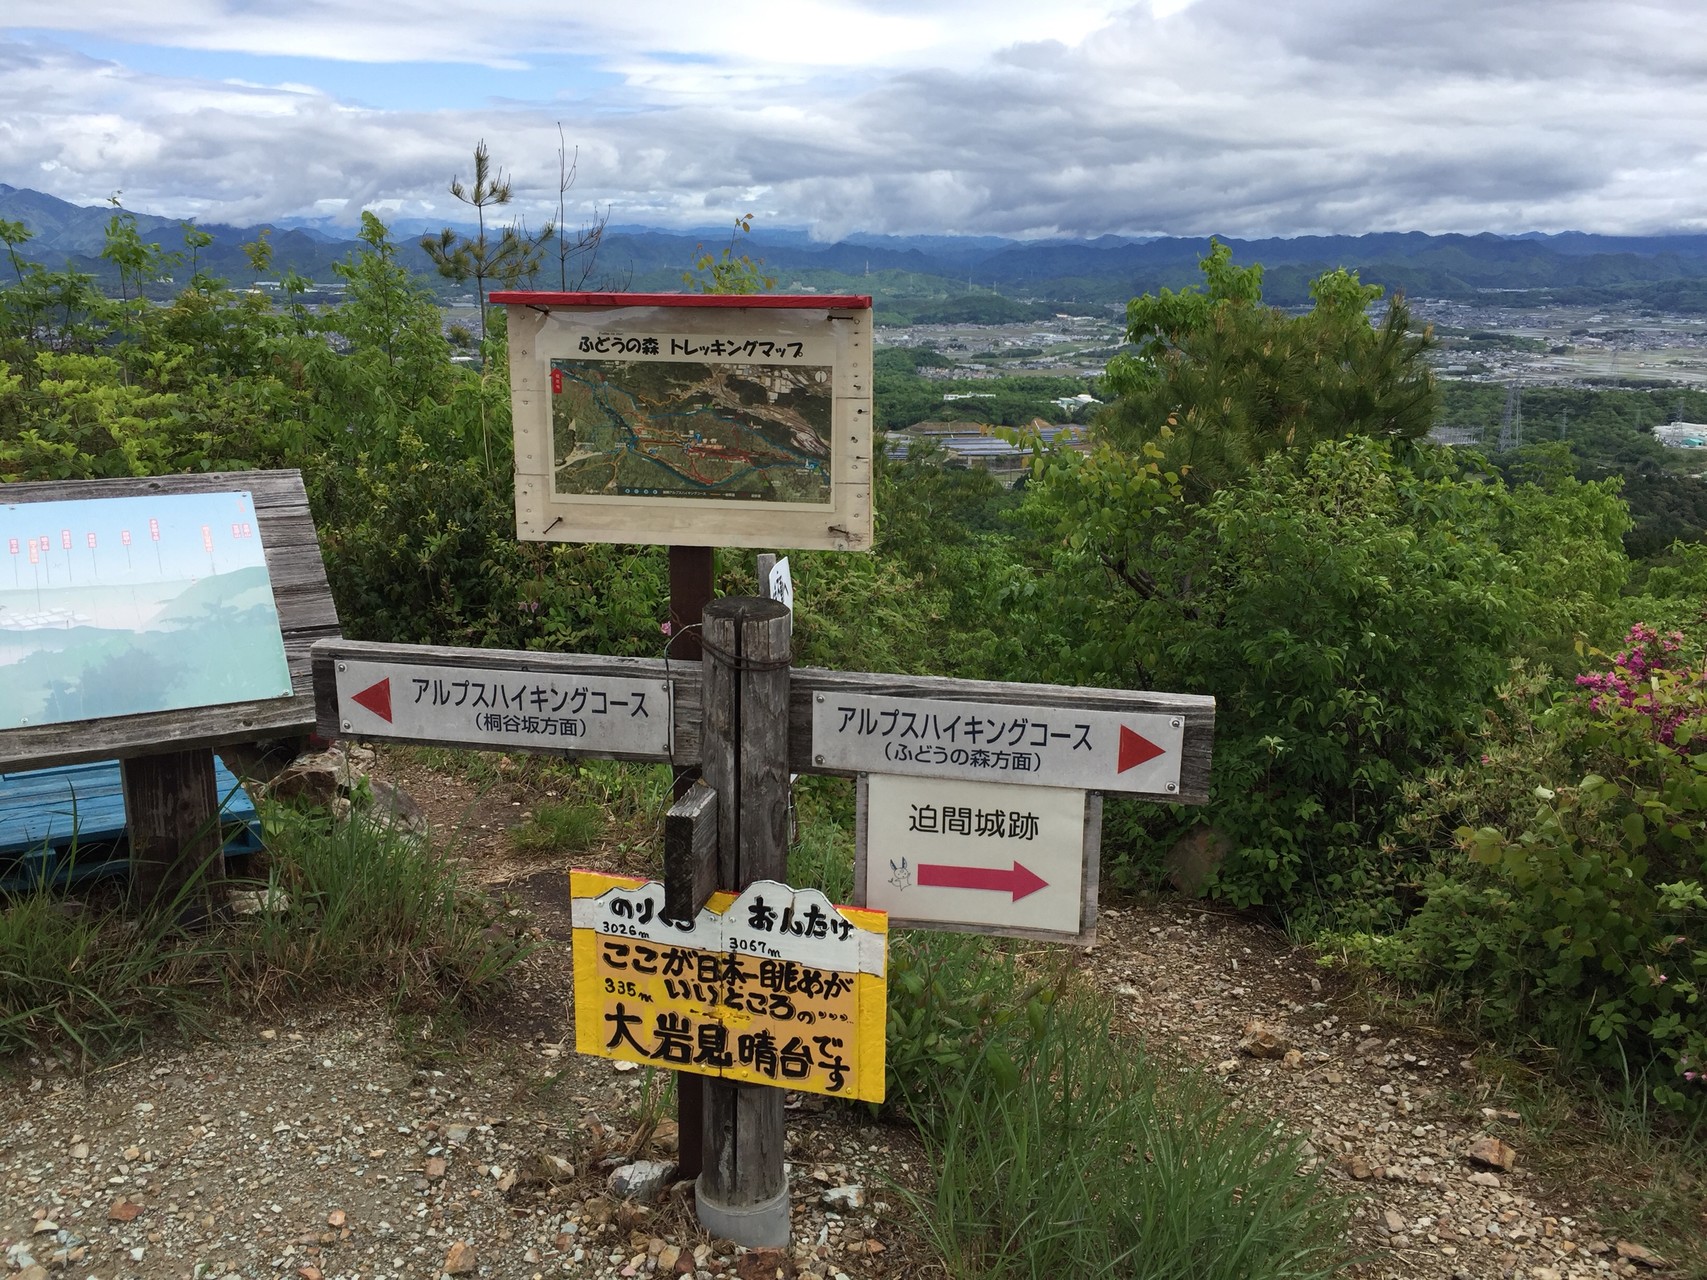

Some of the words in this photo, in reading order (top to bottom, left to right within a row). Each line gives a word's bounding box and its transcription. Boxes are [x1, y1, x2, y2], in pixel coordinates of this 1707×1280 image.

[579, 336, 659, 355] ふどうの森
[671, 338, 804, 359] トレッキングマップ
[412, 678, 649, 718] アルプスハイキングコース
[475, 712, 587, 738] （桐谷坂方面）
[837, 707, 1092, 751] アルプスハイキングコース
[884, 741, 1041, 772] （ふどうの森方面）
[908, 803, 1039, 841] 迫間城跡
[748, 896, 853, 941] おんたけ
[602, 942, 853, 1000] ここが日本一眺めが
